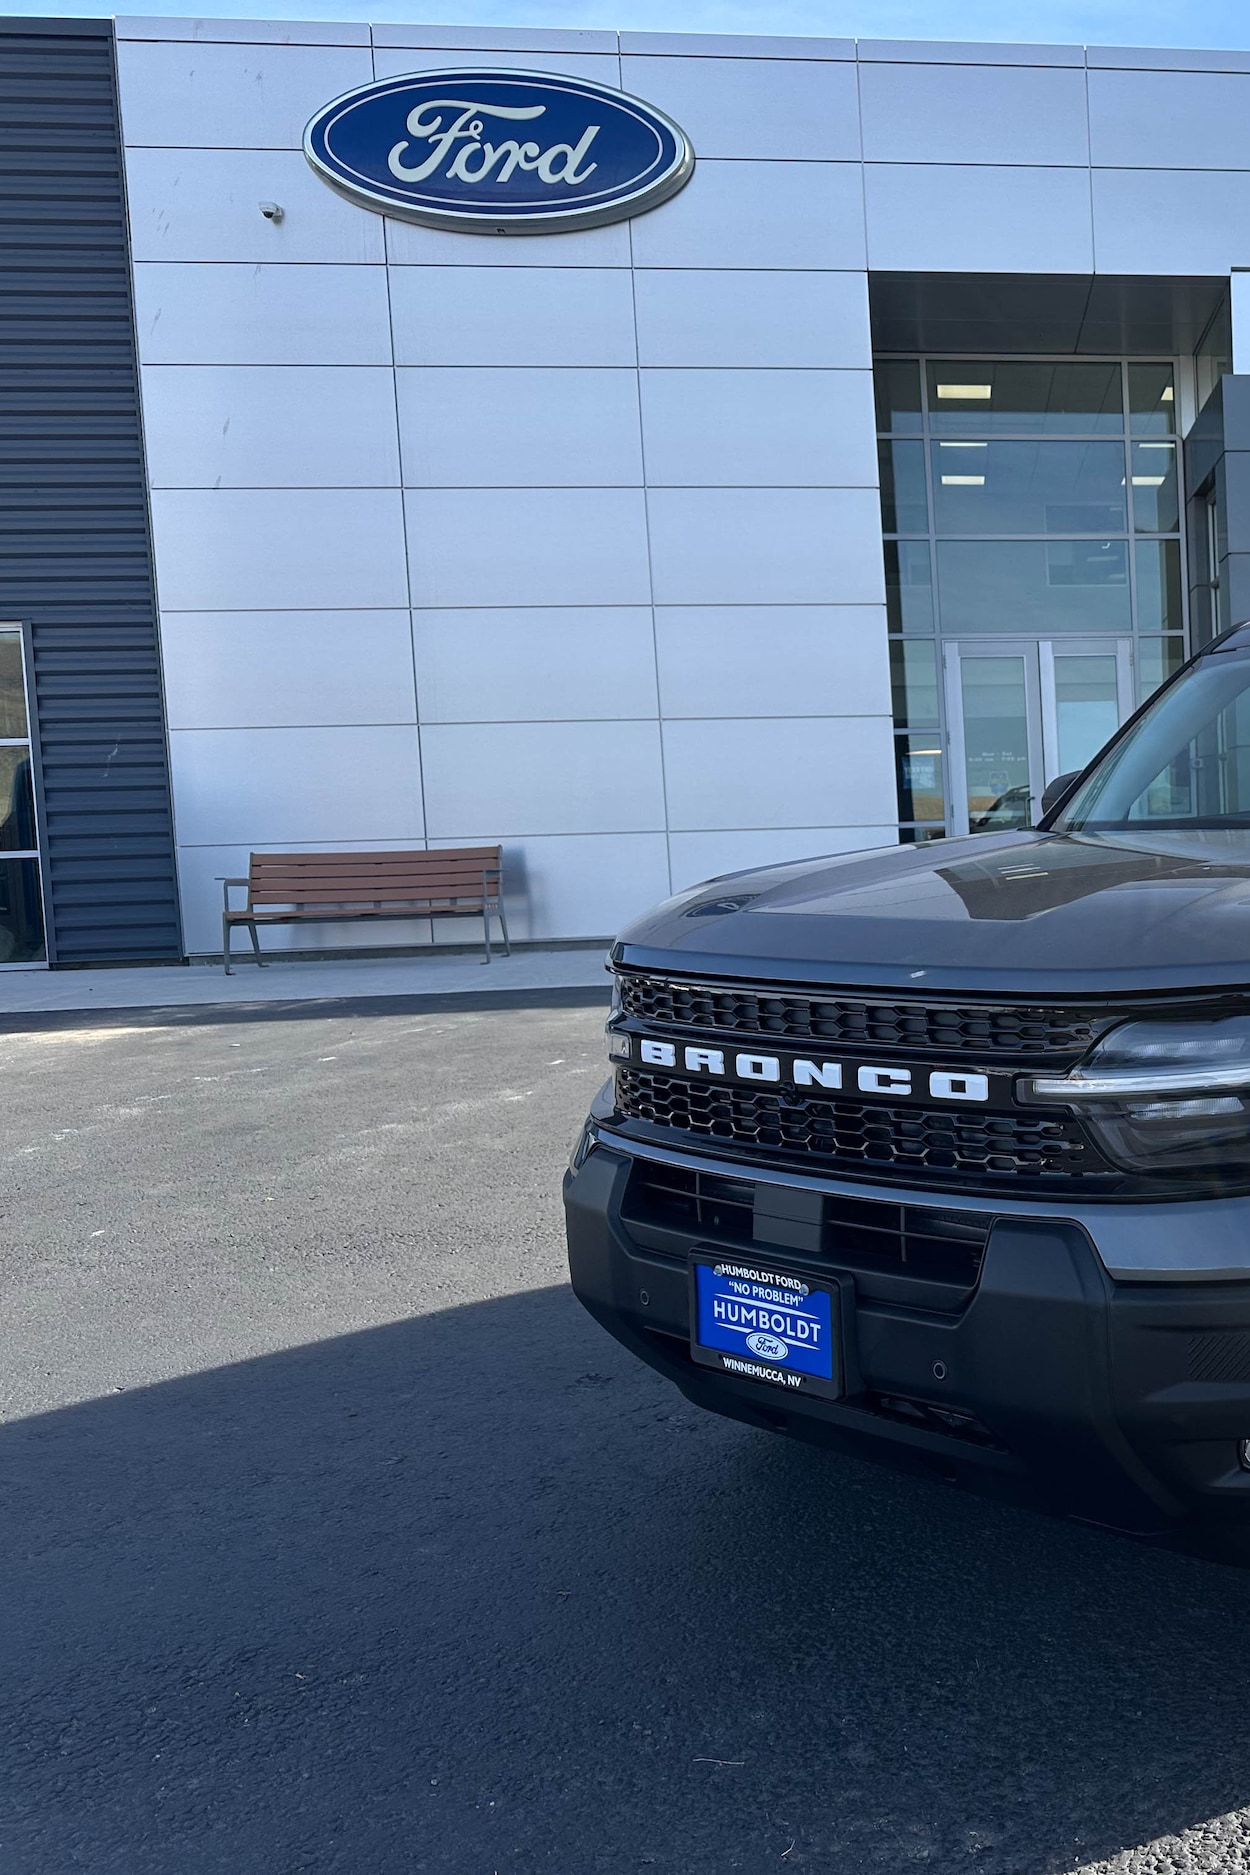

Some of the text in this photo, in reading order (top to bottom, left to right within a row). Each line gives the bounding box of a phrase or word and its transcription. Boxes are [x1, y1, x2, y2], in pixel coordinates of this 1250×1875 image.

[387, 99, 601, 185] Ford
[640, 1039, 989, 1101] BRONCO
[721, 1263, 801, 1290] HUMBOLDT FORD
[713, 1300, 821, 1342] HUMBOLDT
[755, 1336, 779, 1356] Ford
[722, 1357, 802, 1387] WINNEMUCCA, NV
